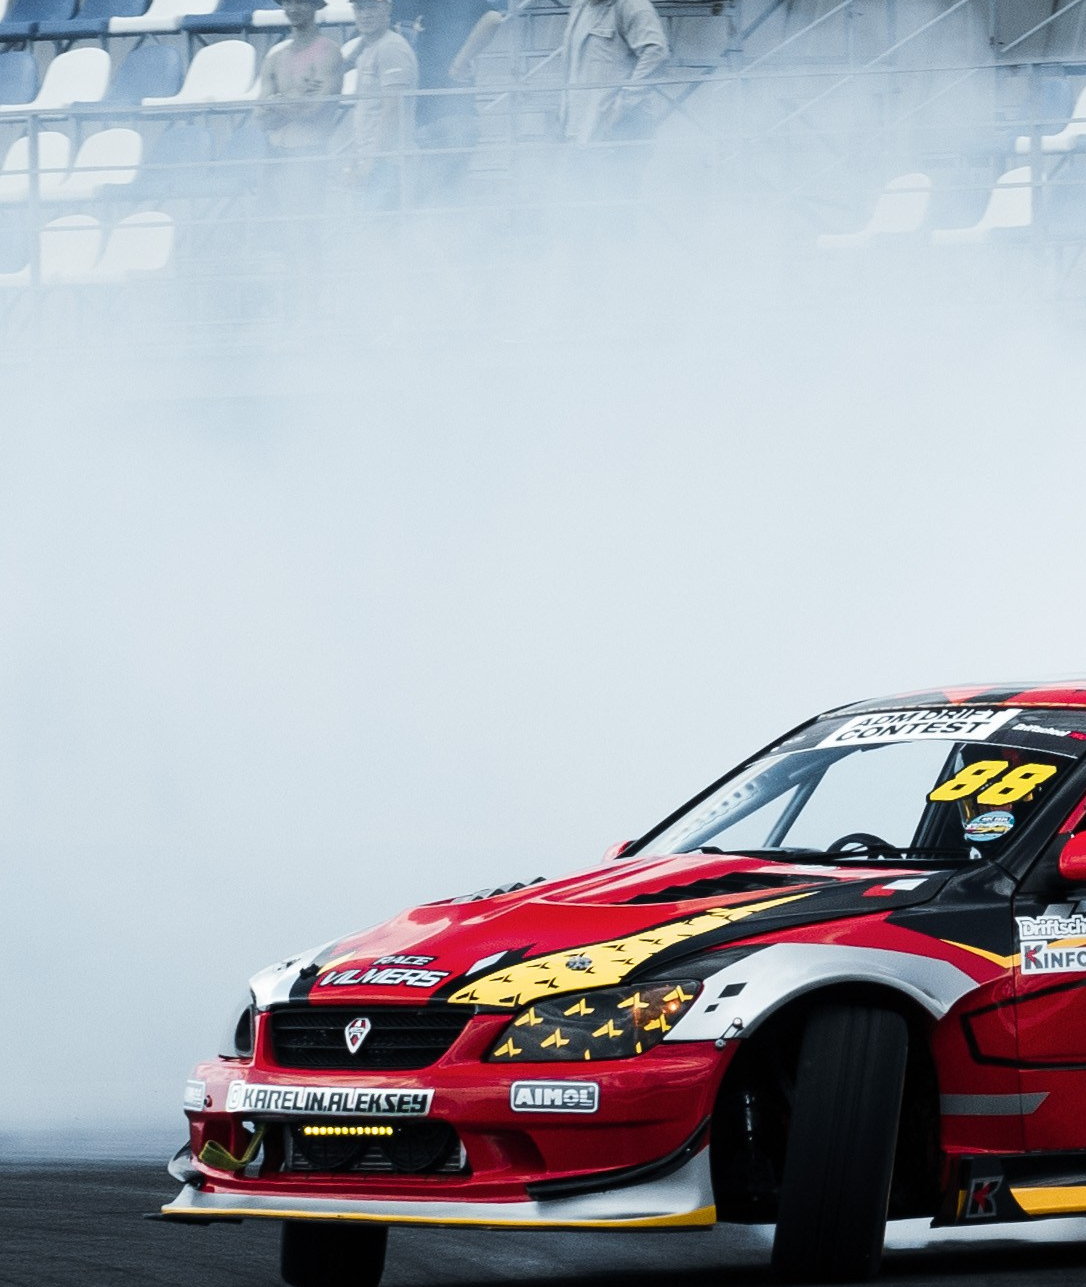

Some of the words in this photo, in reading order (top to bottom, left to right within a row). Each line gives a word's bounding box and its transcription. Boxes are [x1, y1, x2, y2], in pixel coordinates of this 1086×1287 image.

[851, 713, 919, 728] ADM
[834, 721, 991, 742] CONTEST
[928, 760, 1058, 806] 88
[371, 955, 435, 966] RACE
[319, 967, 451, 988] VILMERS
[514, 1087, 594, 1107] AIMOL
